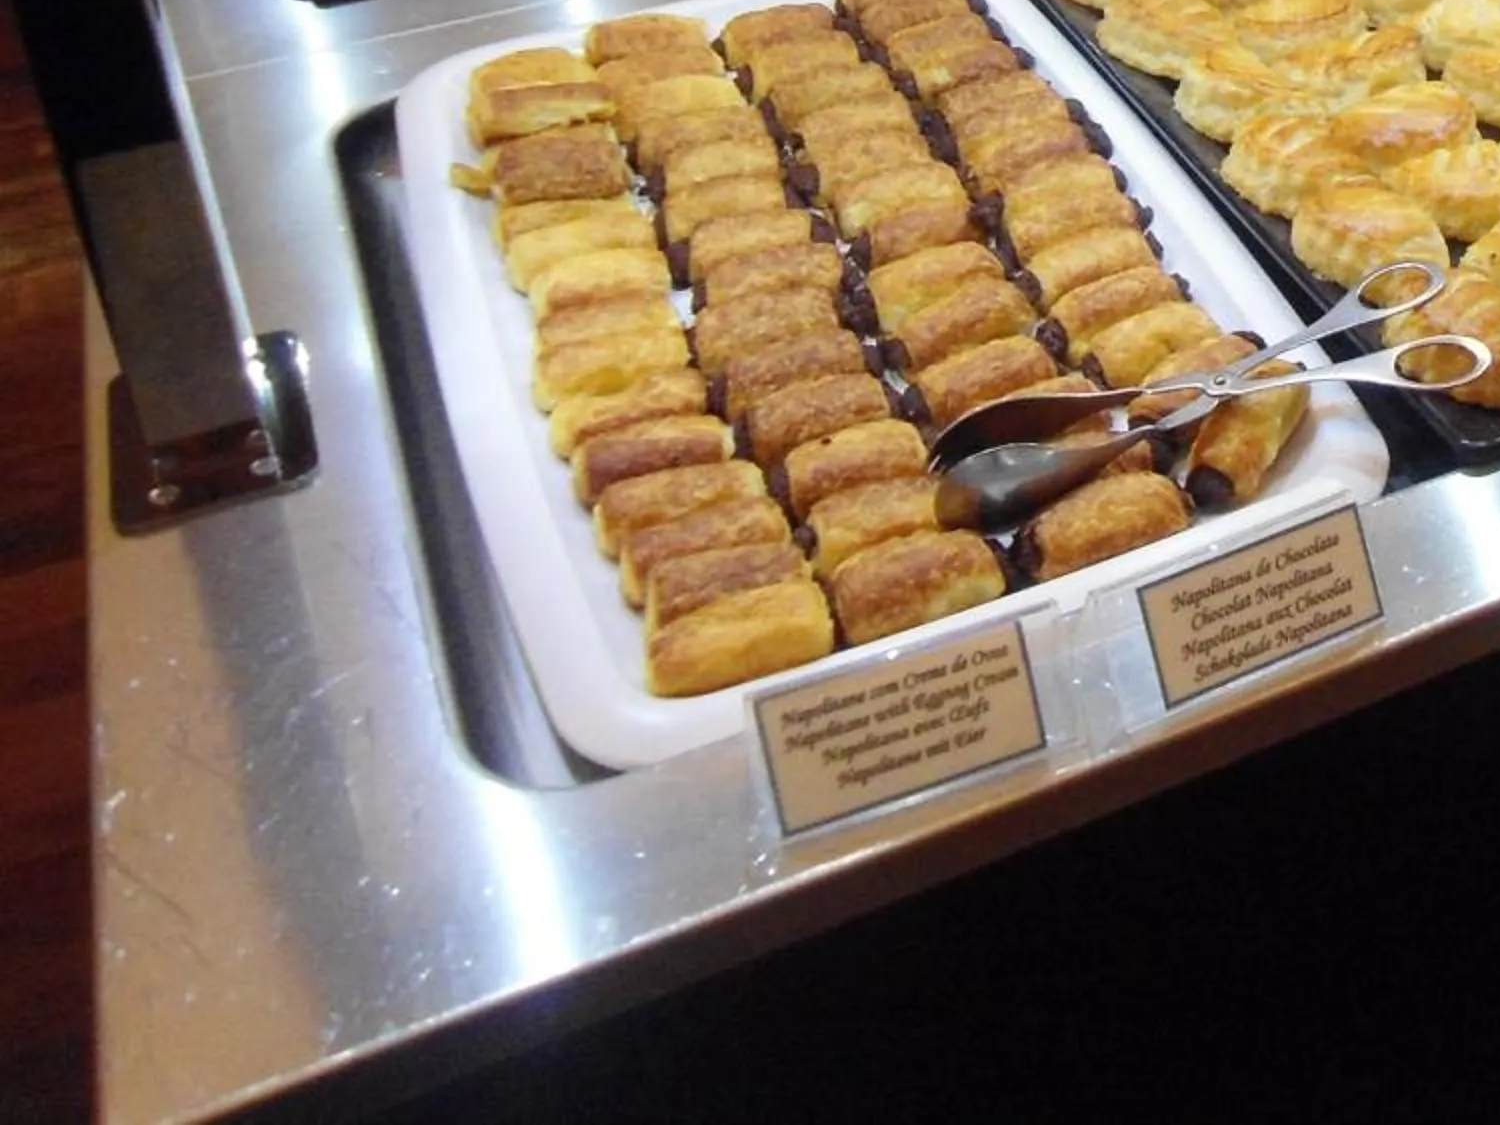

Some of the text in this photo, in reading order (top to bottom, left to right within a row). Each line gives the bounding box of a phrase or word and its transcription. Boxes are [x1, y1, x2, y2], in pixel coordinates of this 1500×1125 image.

[1171, 534, 1340, 612] Napolitana de Chocolate
[1191, 562, 1334, 631] Chocolat Napolitana
[1181, 617, 1262, 661] Napolitana
[1295, 577, 1353, 613] Chocolat
[1275, 605, 1353, 648] Napolitana
[874, 697, 910, 722] with
